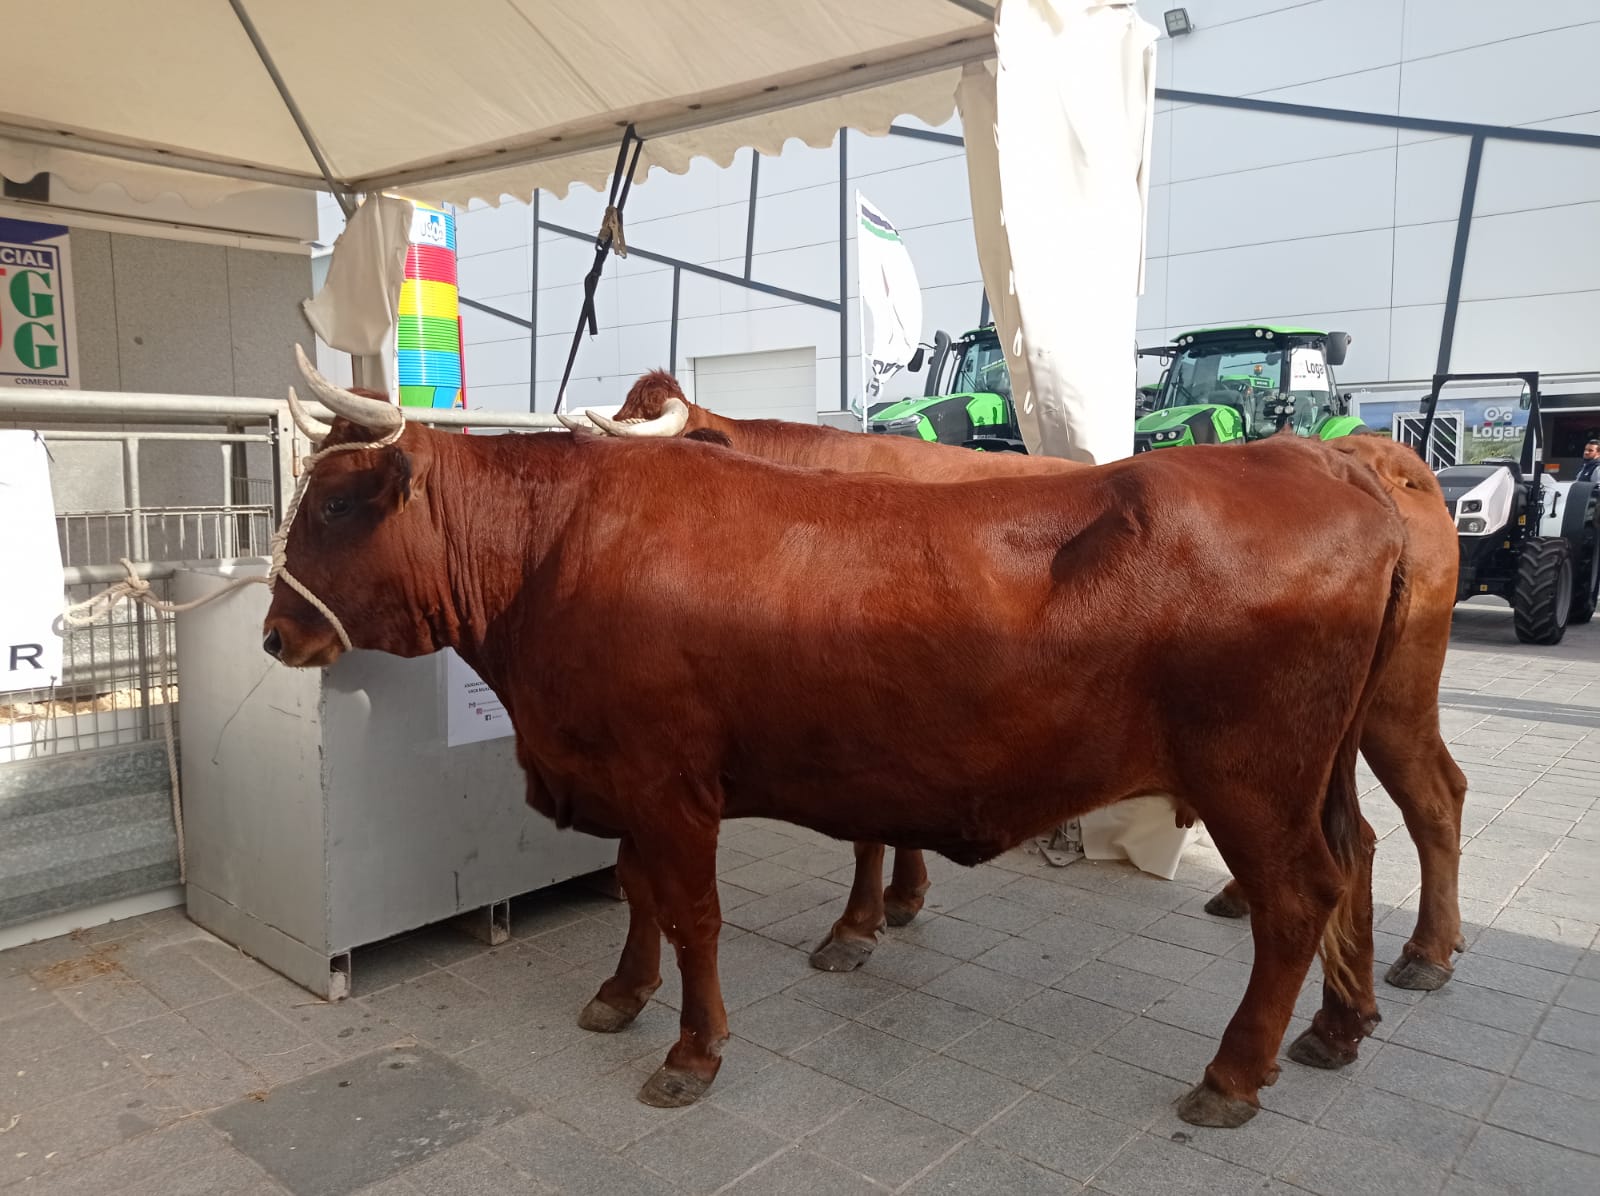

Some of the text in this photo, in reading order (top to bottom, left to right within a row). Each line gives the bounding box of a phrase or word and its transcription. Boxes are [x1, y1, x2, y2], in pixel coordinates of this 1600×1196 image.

[15, 377, 68, 386] COMERCIAL
[1472, 424, 1524, 442] Logar
[8, 643, 45, 672] R
